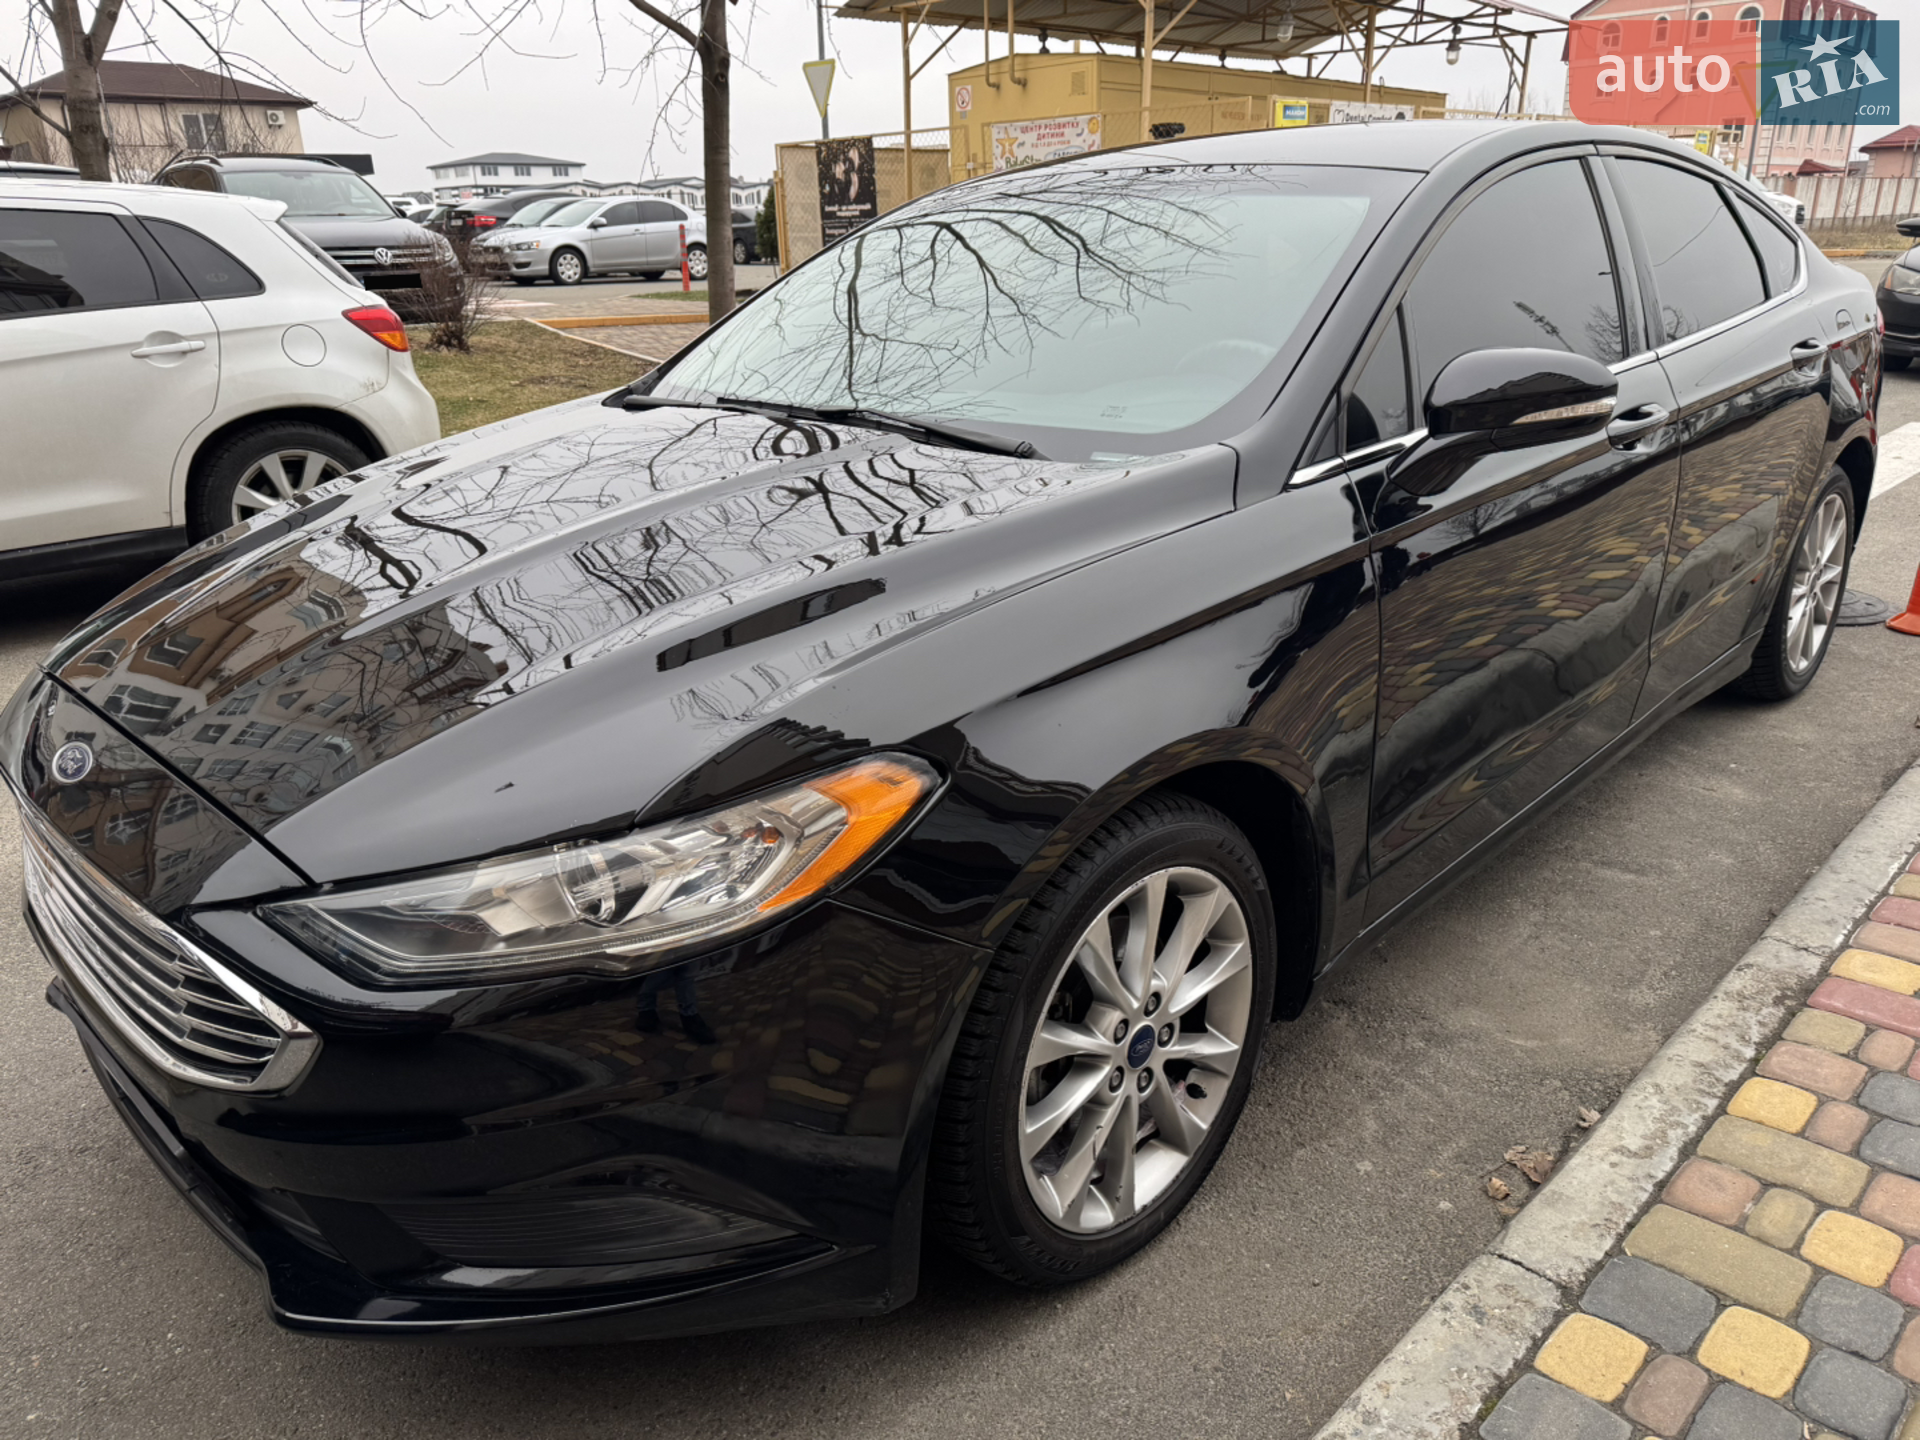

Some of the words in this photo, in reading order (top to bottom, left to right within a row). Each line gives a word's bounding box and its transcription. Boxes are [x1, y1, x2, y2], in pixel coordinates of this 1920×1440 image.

[1020, 125, 1042, 134] ЦЕНТР
[1044, 122, 1079, 131] РОЗВИТКУ
[1037, 131, 1065, 141] ДИТИНИ
